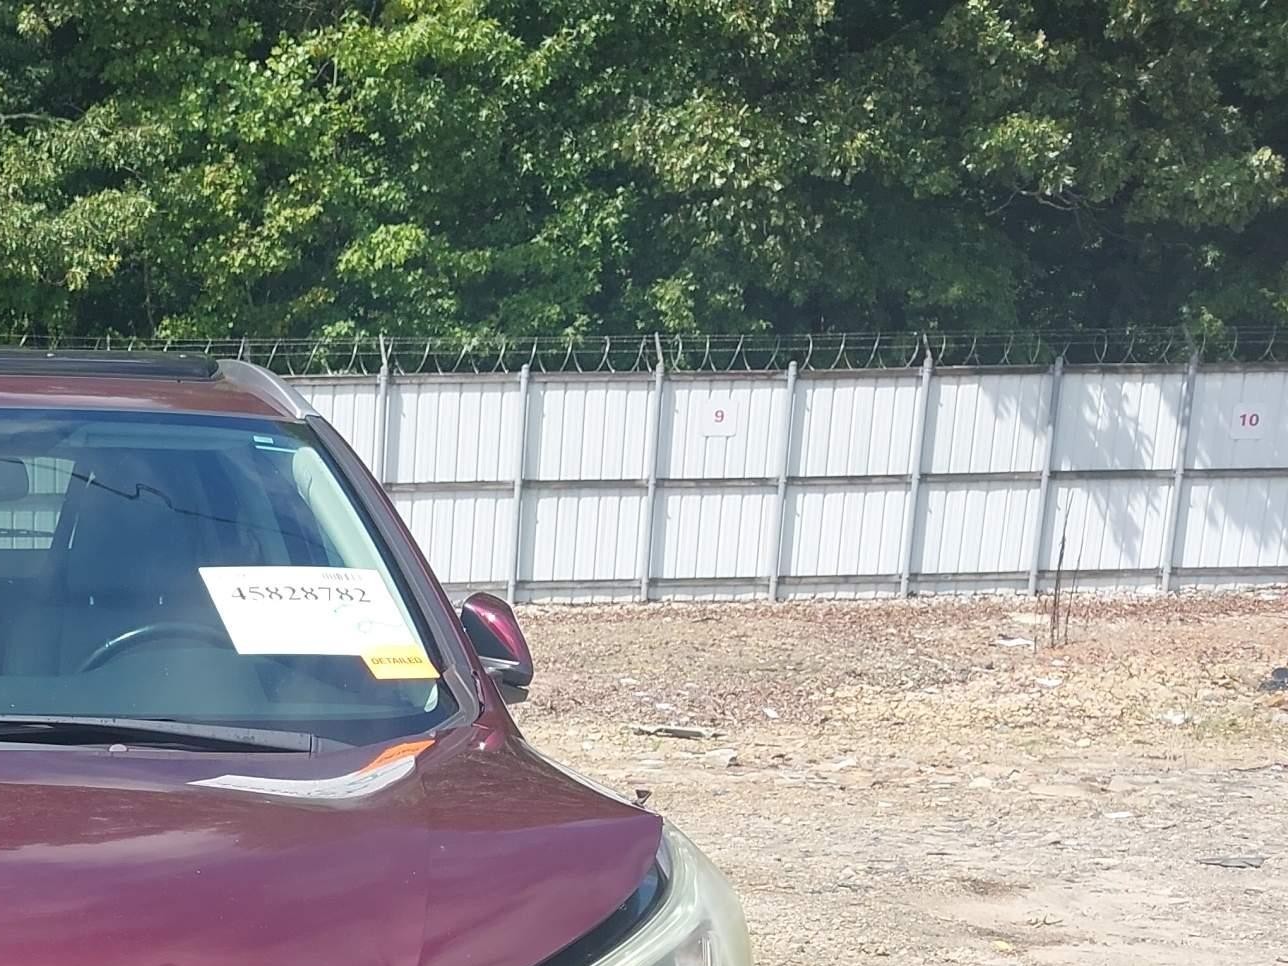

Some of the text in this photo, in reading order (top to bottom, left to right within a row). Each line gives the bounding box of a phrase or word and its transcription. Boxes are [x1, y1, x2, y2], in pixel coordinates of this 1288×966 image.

[714, 409, 725, 423] 9
[1239, 413, 1260, 427] 10
[231, 585, 371, 603] 45828782
[370, 656, 423, 665] DETAILED
